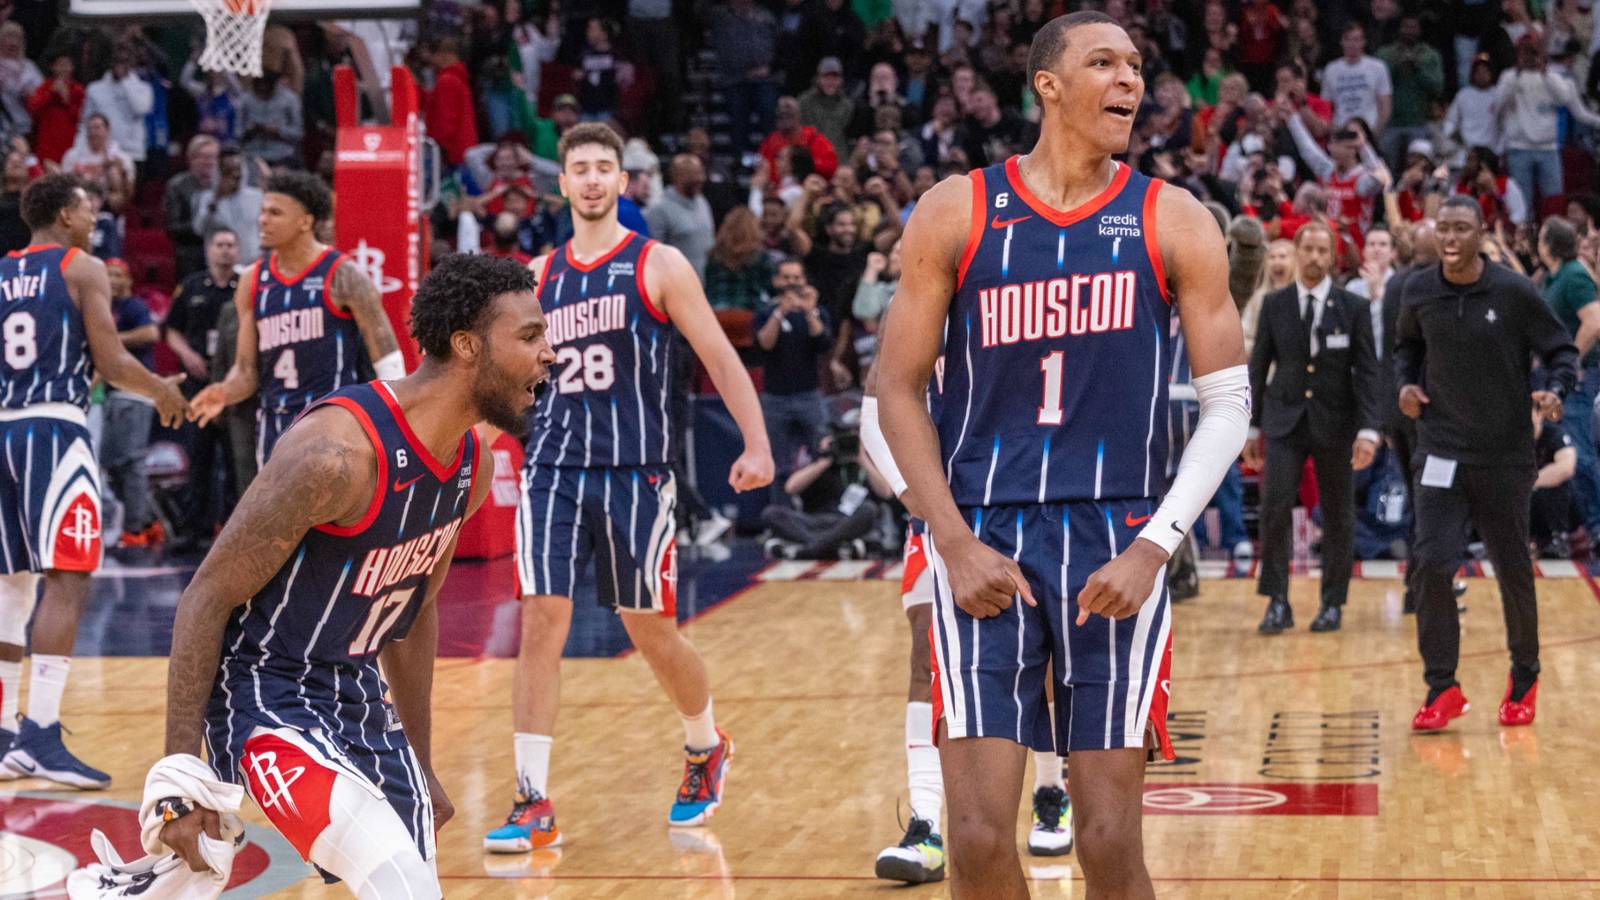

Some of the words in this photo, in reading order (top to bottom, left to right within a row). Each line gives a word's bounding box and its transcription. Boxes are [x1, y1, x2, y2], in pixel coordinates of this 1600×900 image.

[994, 192, 1009, 209] 6
[1100, 214, 1139, 226] credit
[1098, 224, 1141, 237] karma
[978, 270, 1137, 349] HOUSTON
[2, 311, 38, 370] 8
[273, 348, 300, 389] 4
[555, 343, 616, 394] 28
[1036, 350, 1064, 425] 1
[396, 448, 408, 468] 6
[348, 586, 417, 656] 17
